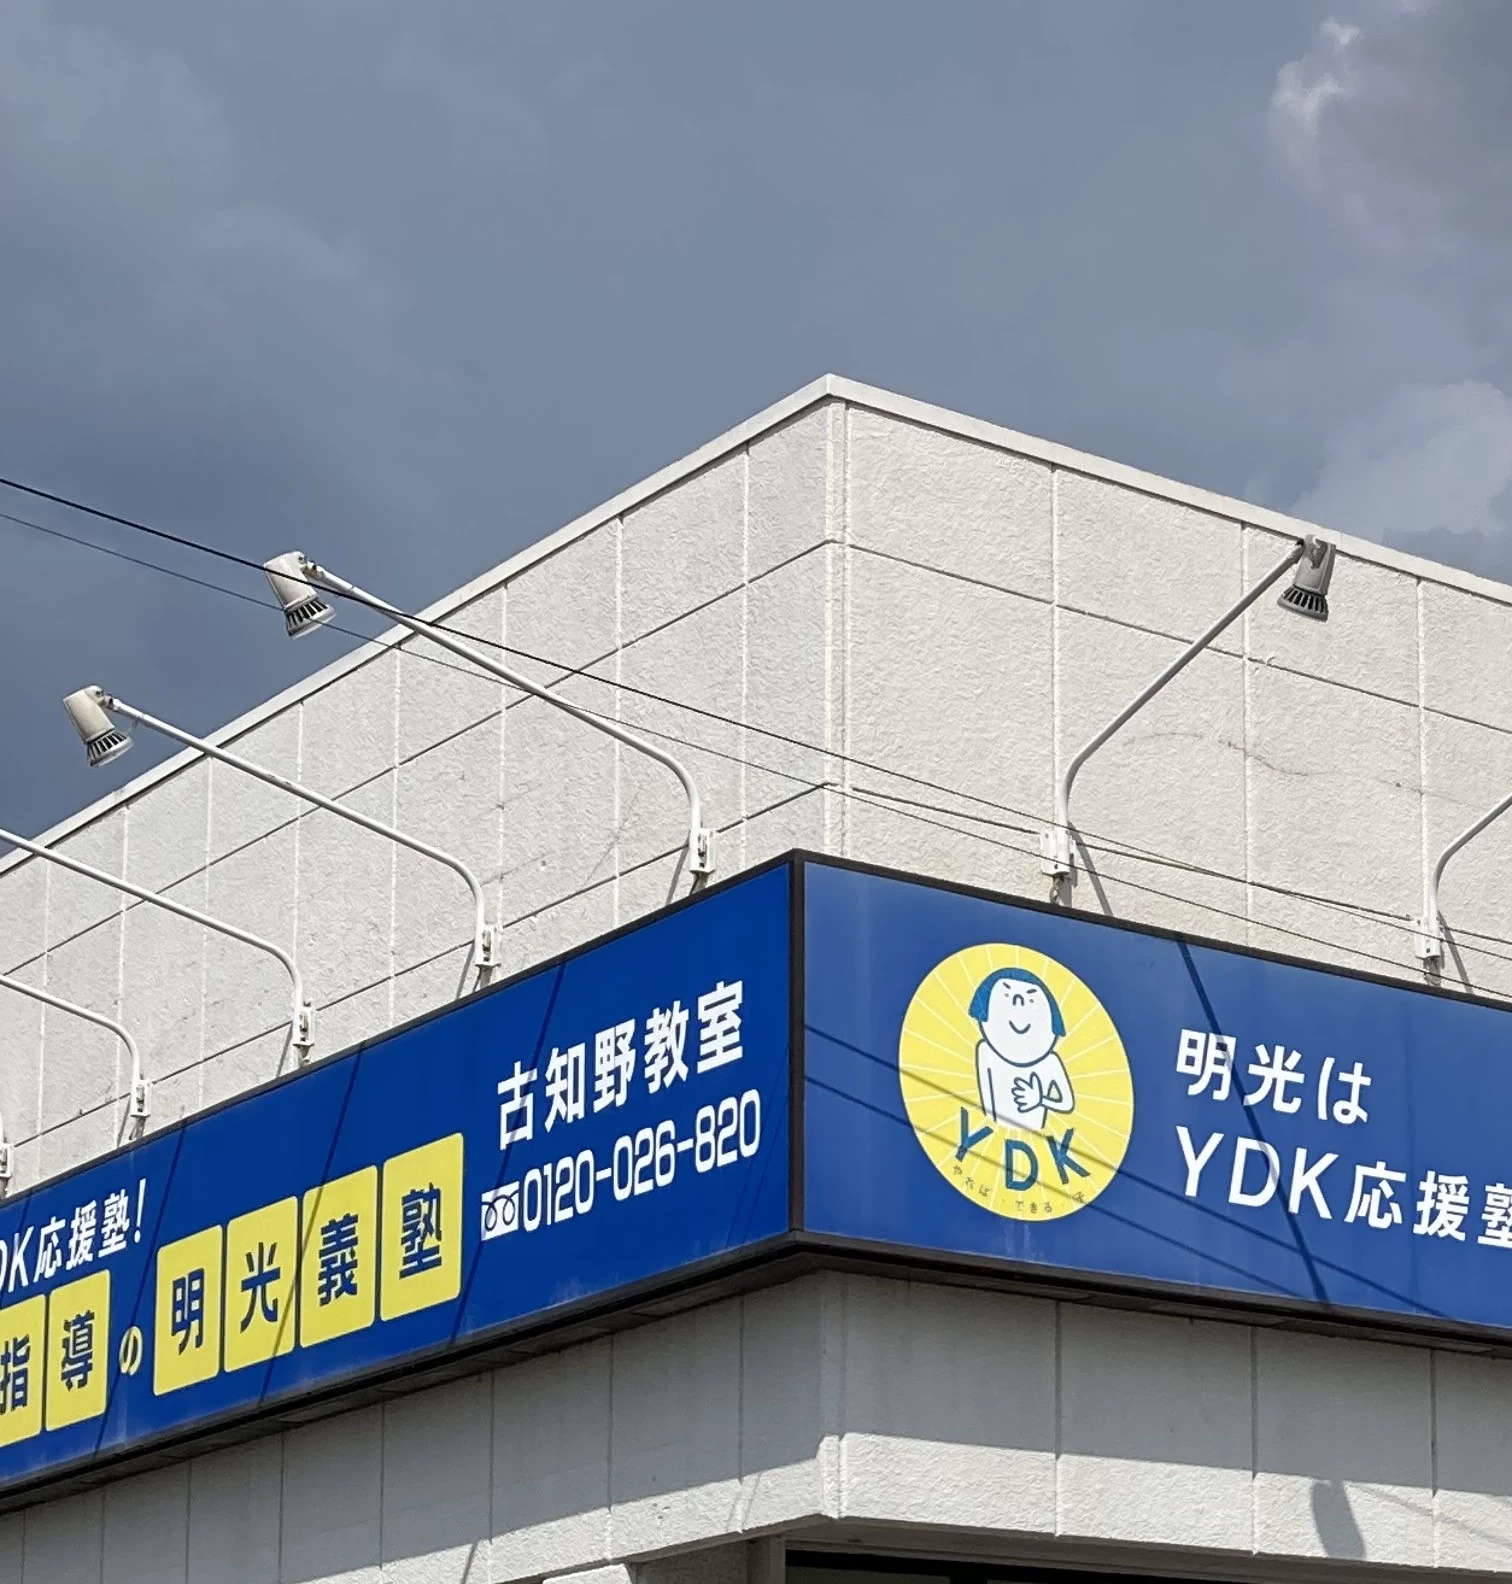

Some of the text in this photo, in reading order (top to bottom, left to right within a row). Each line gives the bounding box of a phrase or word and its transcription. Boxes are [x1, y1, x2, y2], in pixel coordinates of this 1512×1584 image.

[498, 980, 744, 1150] 古知野教室
[1176, 1028, 1372, 1125] 明光は
[522, 1089, 761, 1232] 0120-026-820
[955, 1106, 1090, 1191] YDK
